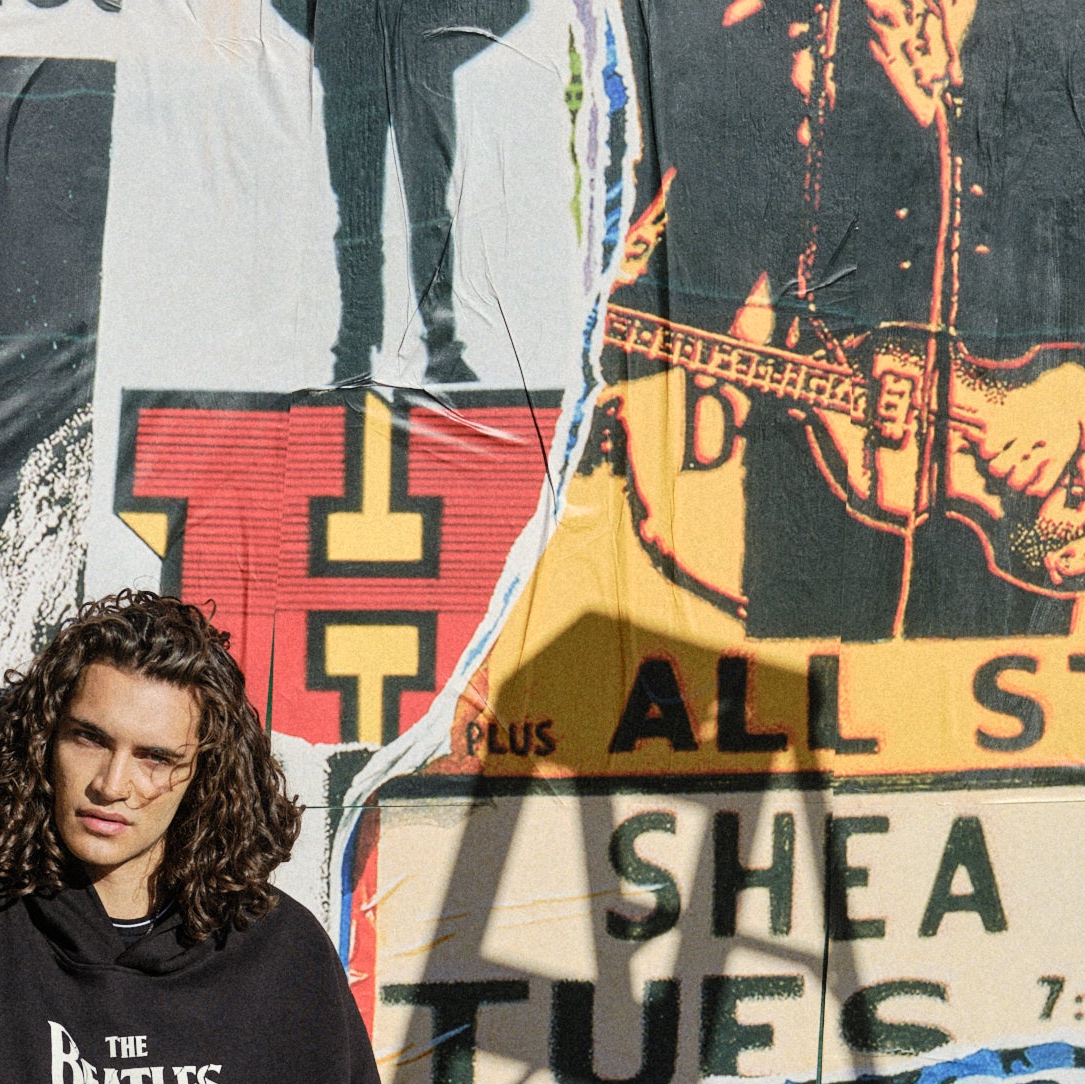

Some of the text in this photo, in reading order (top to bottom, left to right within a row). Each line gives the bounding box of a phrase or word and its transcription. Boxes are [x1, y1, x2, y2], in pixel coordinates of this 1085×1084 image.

[466, 652, 1085, 756] PLUS ALL S
[606, 810, 1008, 942] SHEA
[105, 1035, 148, 1059] THE
